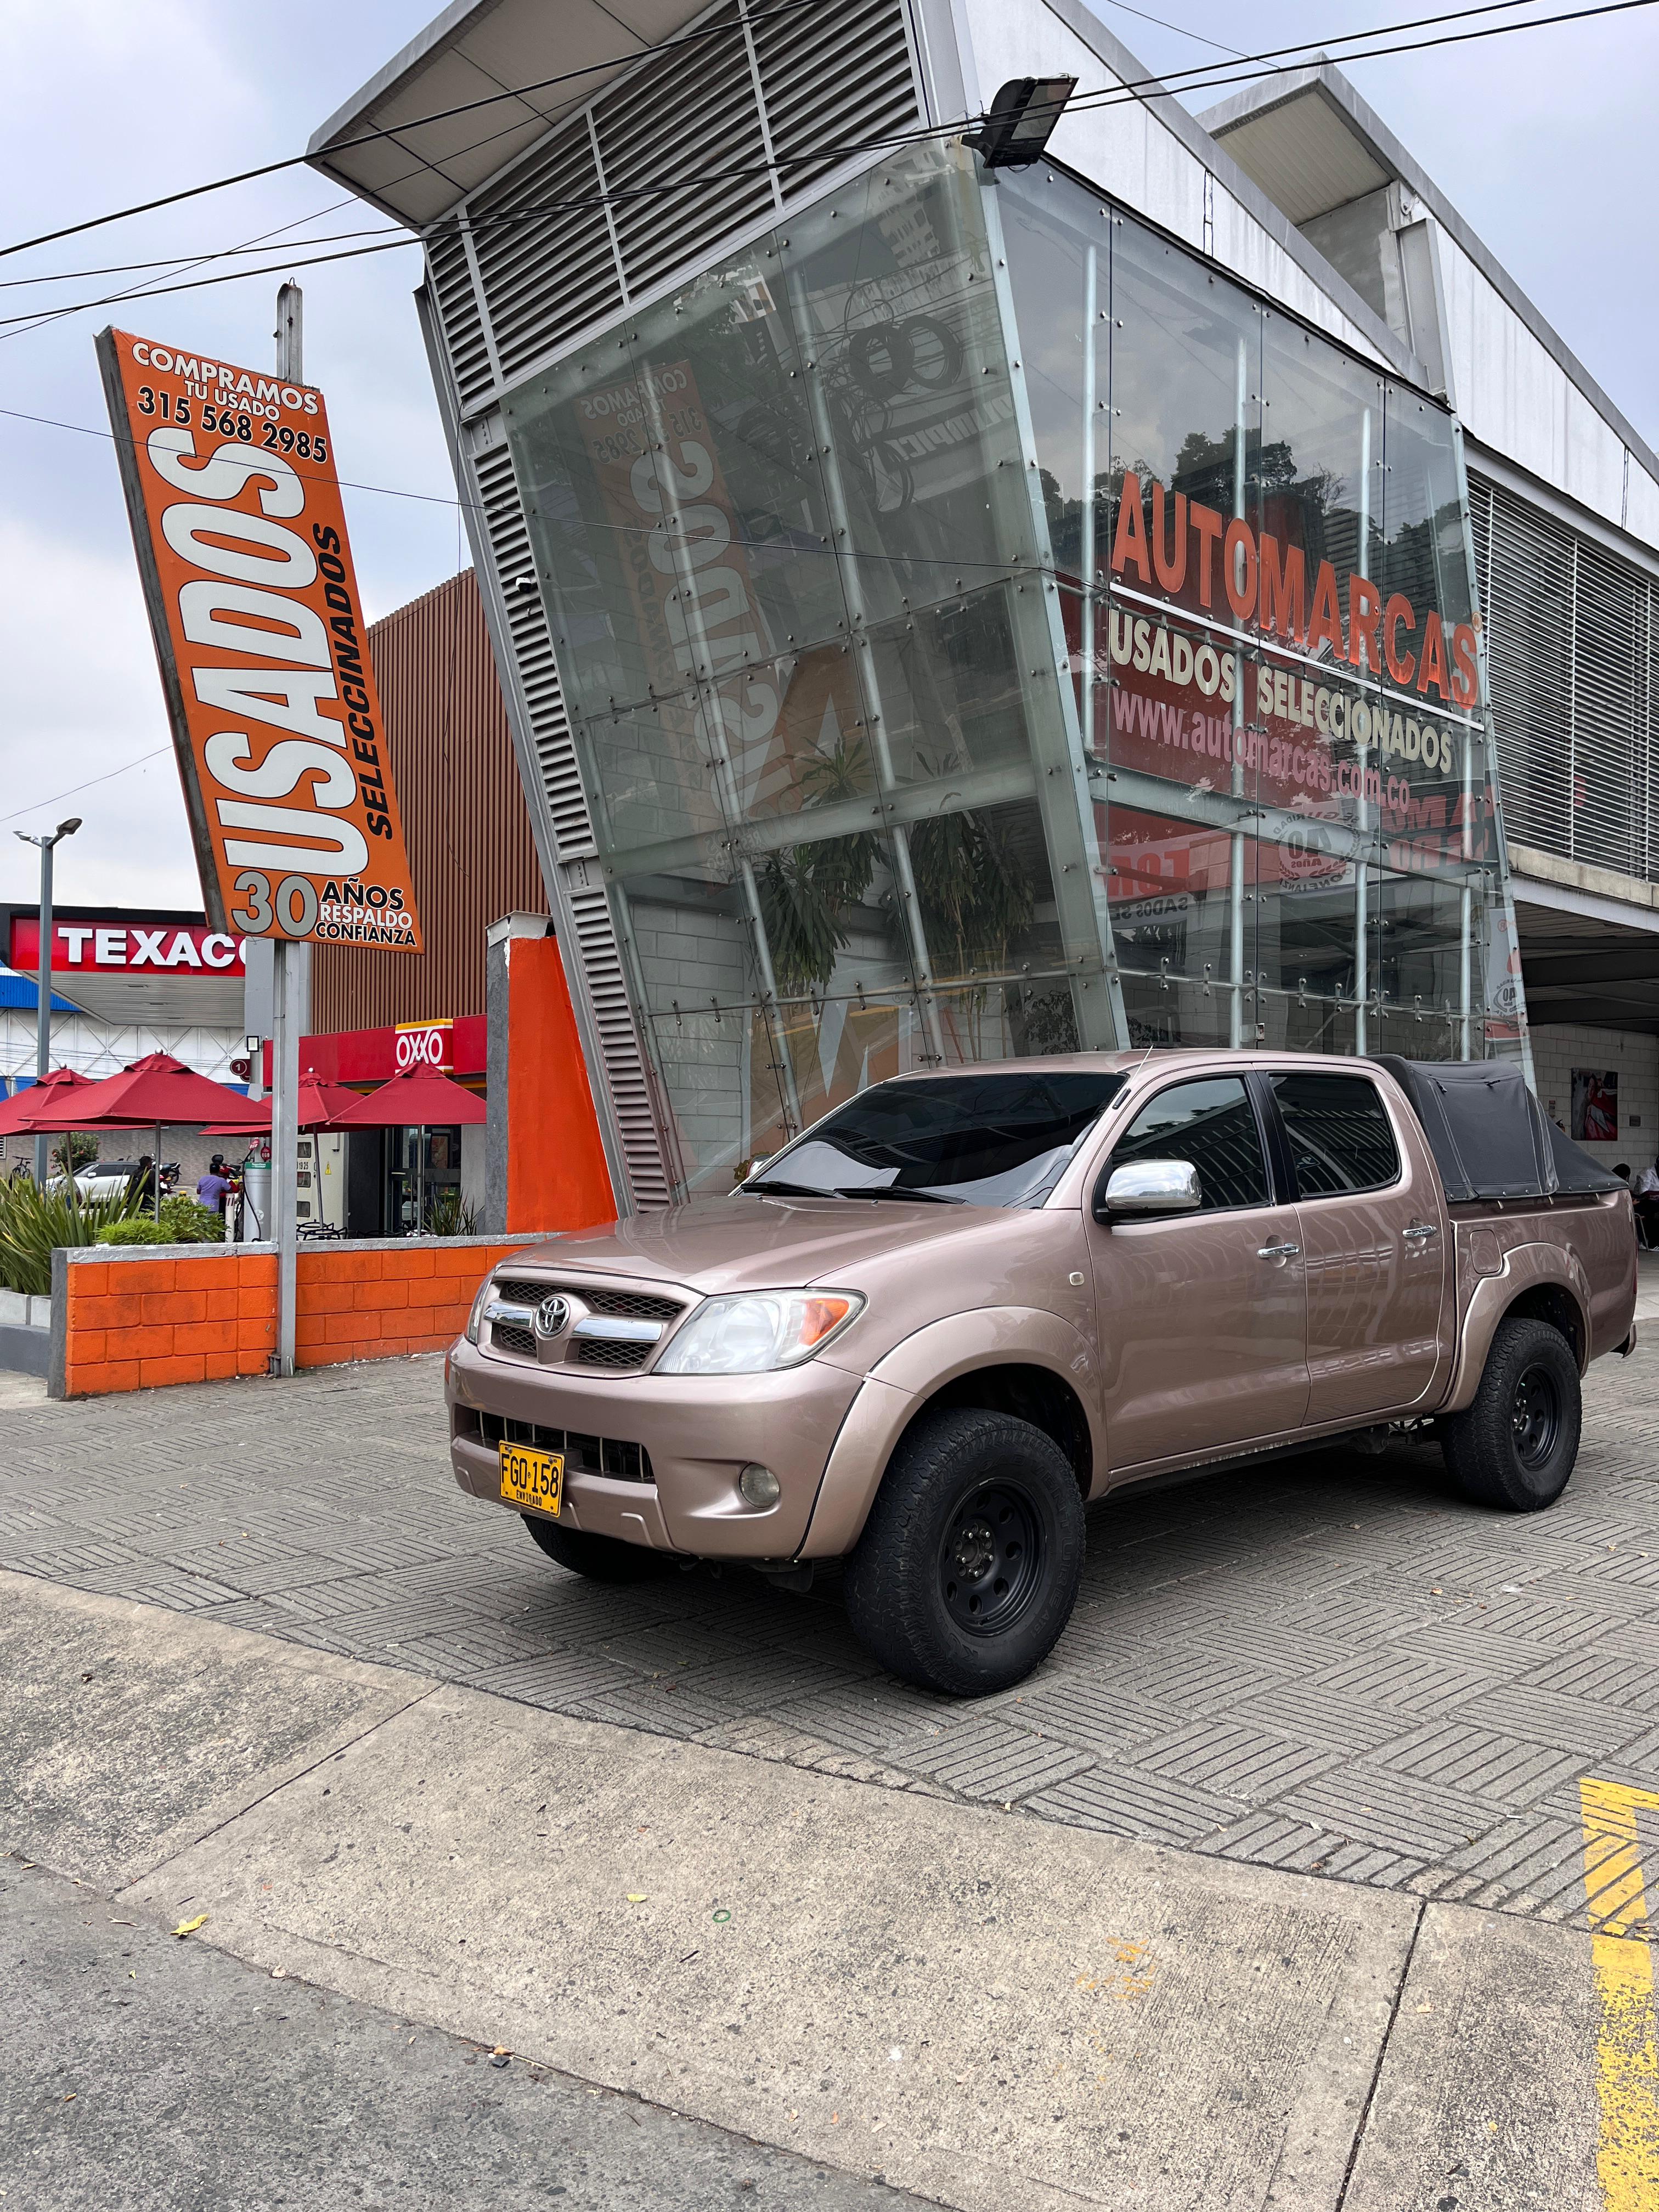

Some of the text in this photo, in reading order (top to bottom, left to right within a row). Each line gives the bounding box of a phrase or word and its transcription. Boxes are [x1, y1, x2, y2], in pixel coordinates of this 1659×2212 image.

[132, 342, 319, 415] COMPRAMOS
[184, 380, 281, 421] TU USADO
[137, 386, 327, 464] 315 568 2985
[1111, 470, 1479, 710] AUTOMARCAS
[146, 426, 369, 877] USADOS
[313, 522, 392, 840] SELECCINADOS
[1110, 608, 1452, 774] USADOS SELECCIONADOS
[1113, 687, 1410, 814] www.automarcas.com.co
[231, 870, 405, 937] 30 AÑOS
[315, 922, 417, 947] CONFIANZA
[320, 904, 413, 929] RESPALDO
[58, 927, 245, 968] TEXAC
[396, 1029, 443, 1067] OXXO
[516, 1489, 542, 1506] ENVIGADO
